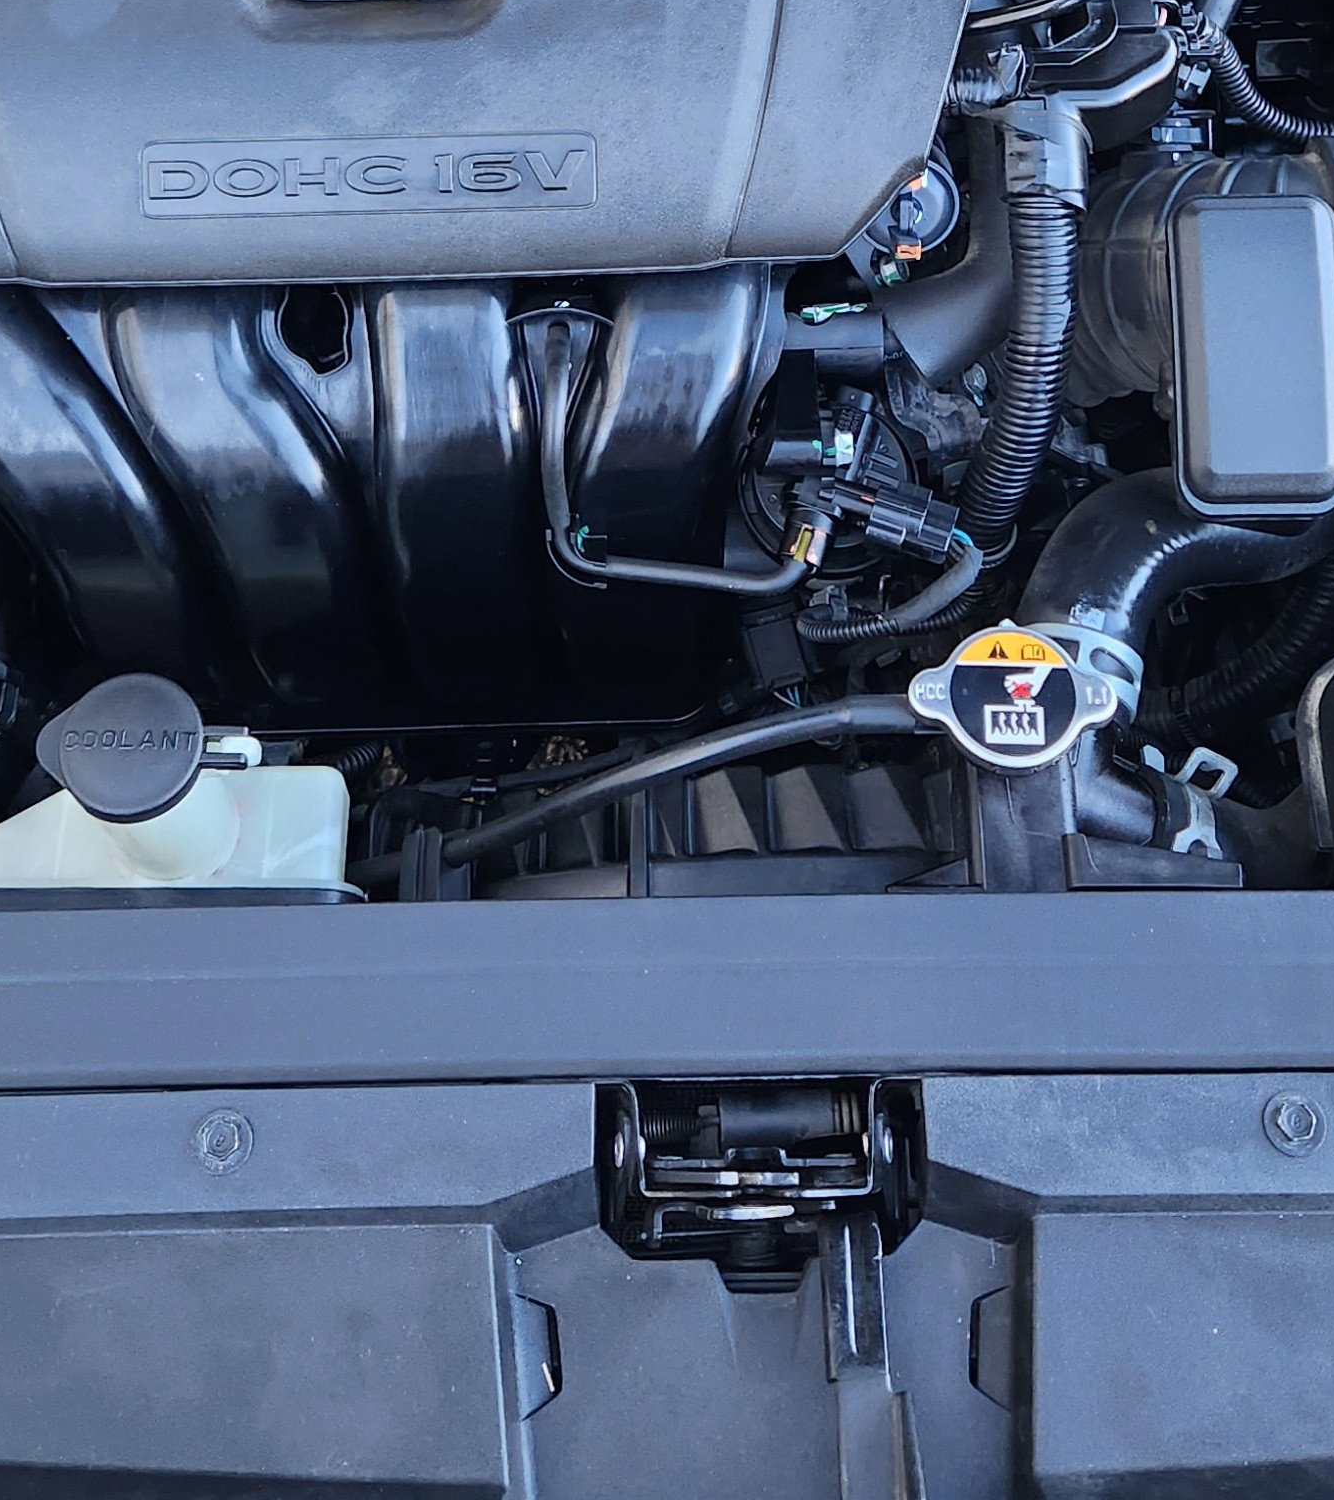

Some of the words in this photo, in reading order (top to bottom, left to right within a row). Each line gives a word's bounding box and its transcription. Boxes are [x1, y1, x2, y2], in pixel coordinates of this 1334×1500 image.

[148, 155, 408, 199] DOHC
[434, 150, 587, 194] 16V
[65, 726, 198, 751] COOLANT
